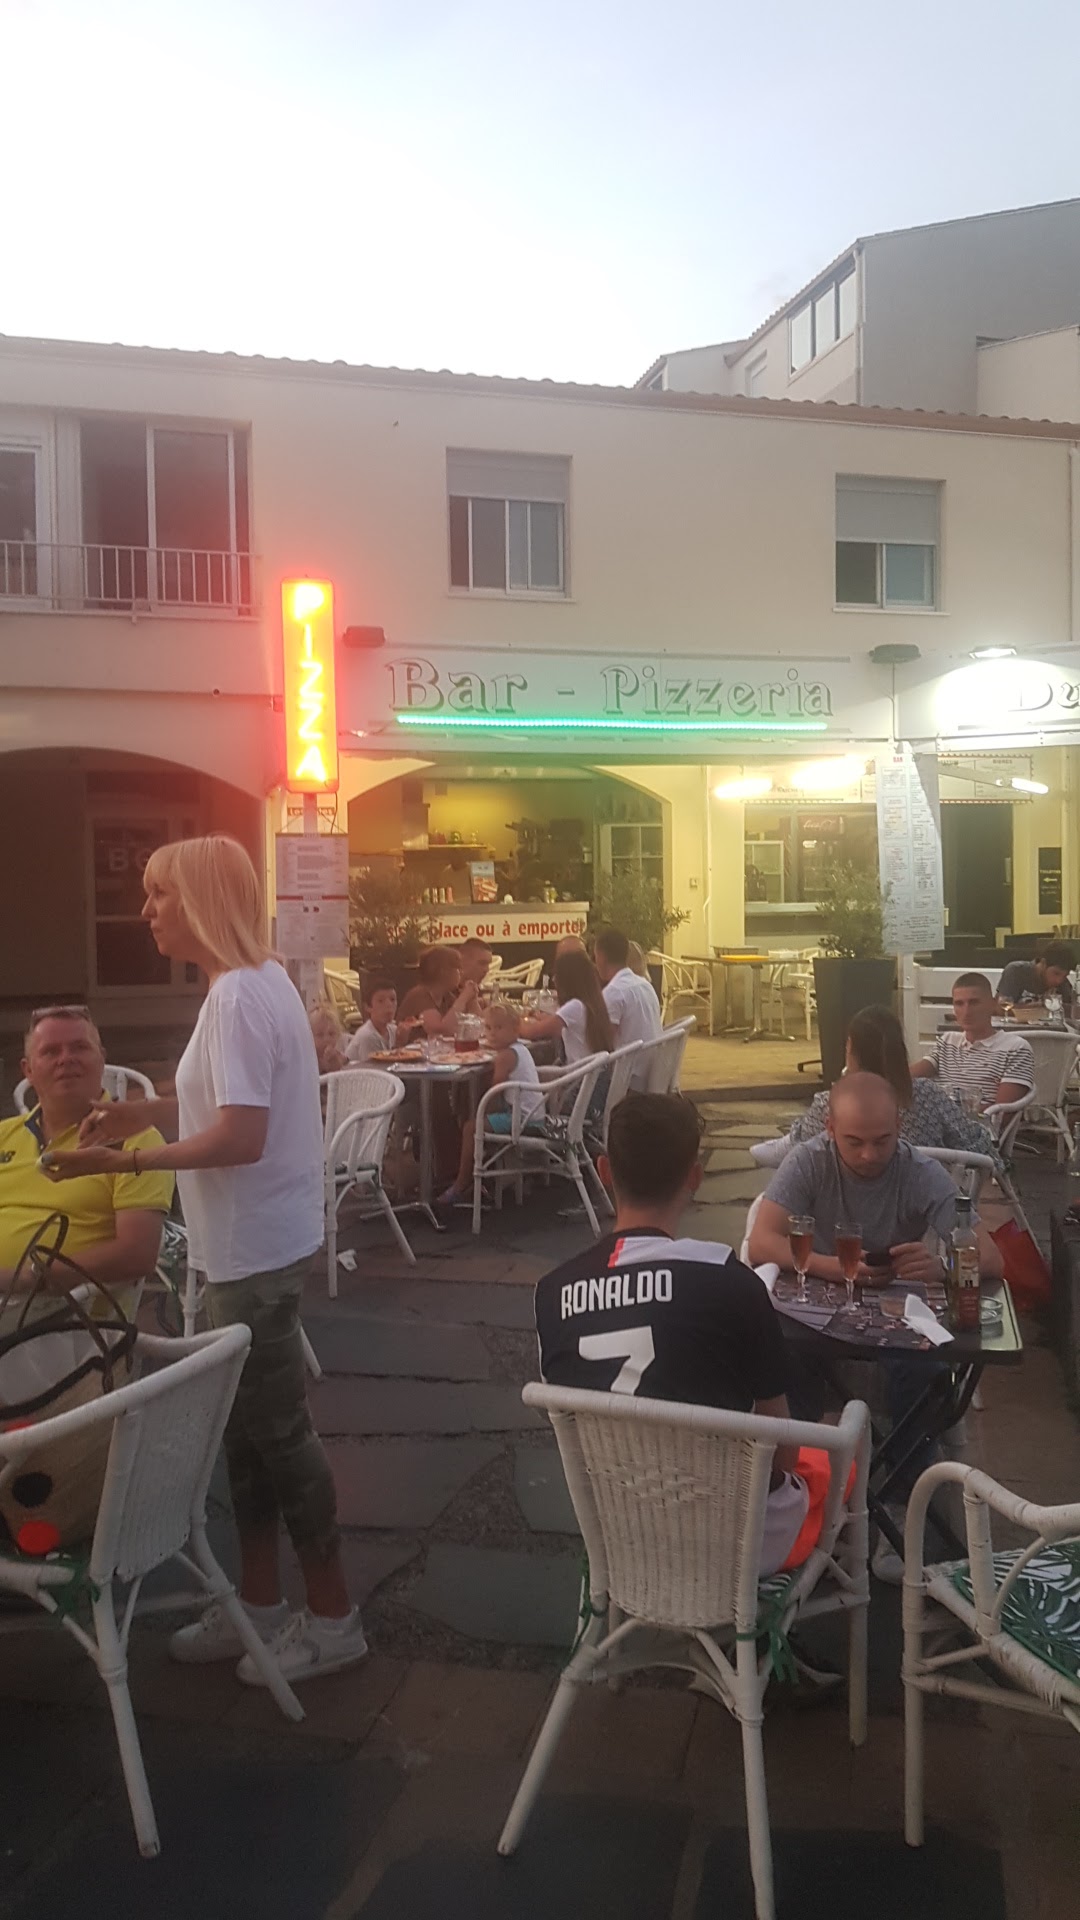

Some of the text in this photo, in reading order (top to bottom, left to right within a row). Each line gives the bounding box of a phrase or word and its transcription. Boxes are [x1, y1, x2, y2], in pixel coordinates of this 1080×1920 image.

[294, 583, 327, 782] PIZZA
[385, 657, 528, 714] Bar
[600, 664, 834, 718] Pizzeria
[427, 921, 468, 942] place
[476, 924, 494, 937] ou
[502, 920, 511, 937] à
[561, 1269, 673, 1320] RONALDO
[579, 1325, 655, 1396] 7
